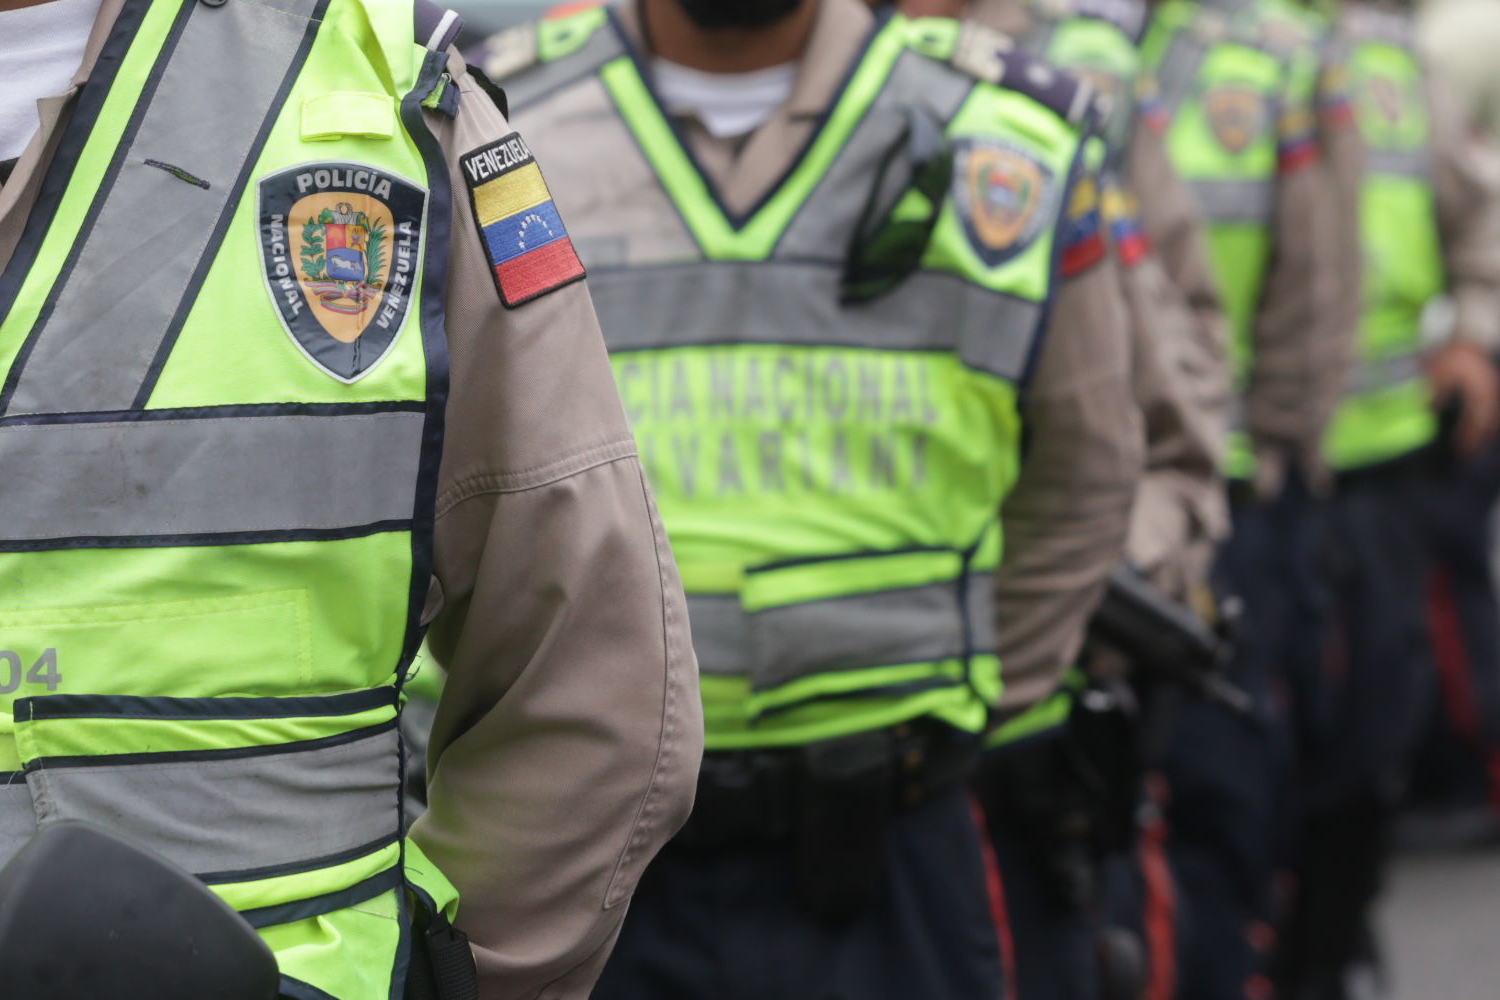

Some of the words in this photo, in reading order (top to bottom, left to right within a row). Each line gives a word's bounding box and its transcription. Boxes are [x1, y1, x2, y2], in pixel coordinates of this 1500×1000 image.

[296, 169, 392, 200] POLICÍA
[464, 136, 533, 181] VENEZUELA
[270, 213, 304, 315] NACIONAL
[376, 221, 412, 329] VENEZUELA
